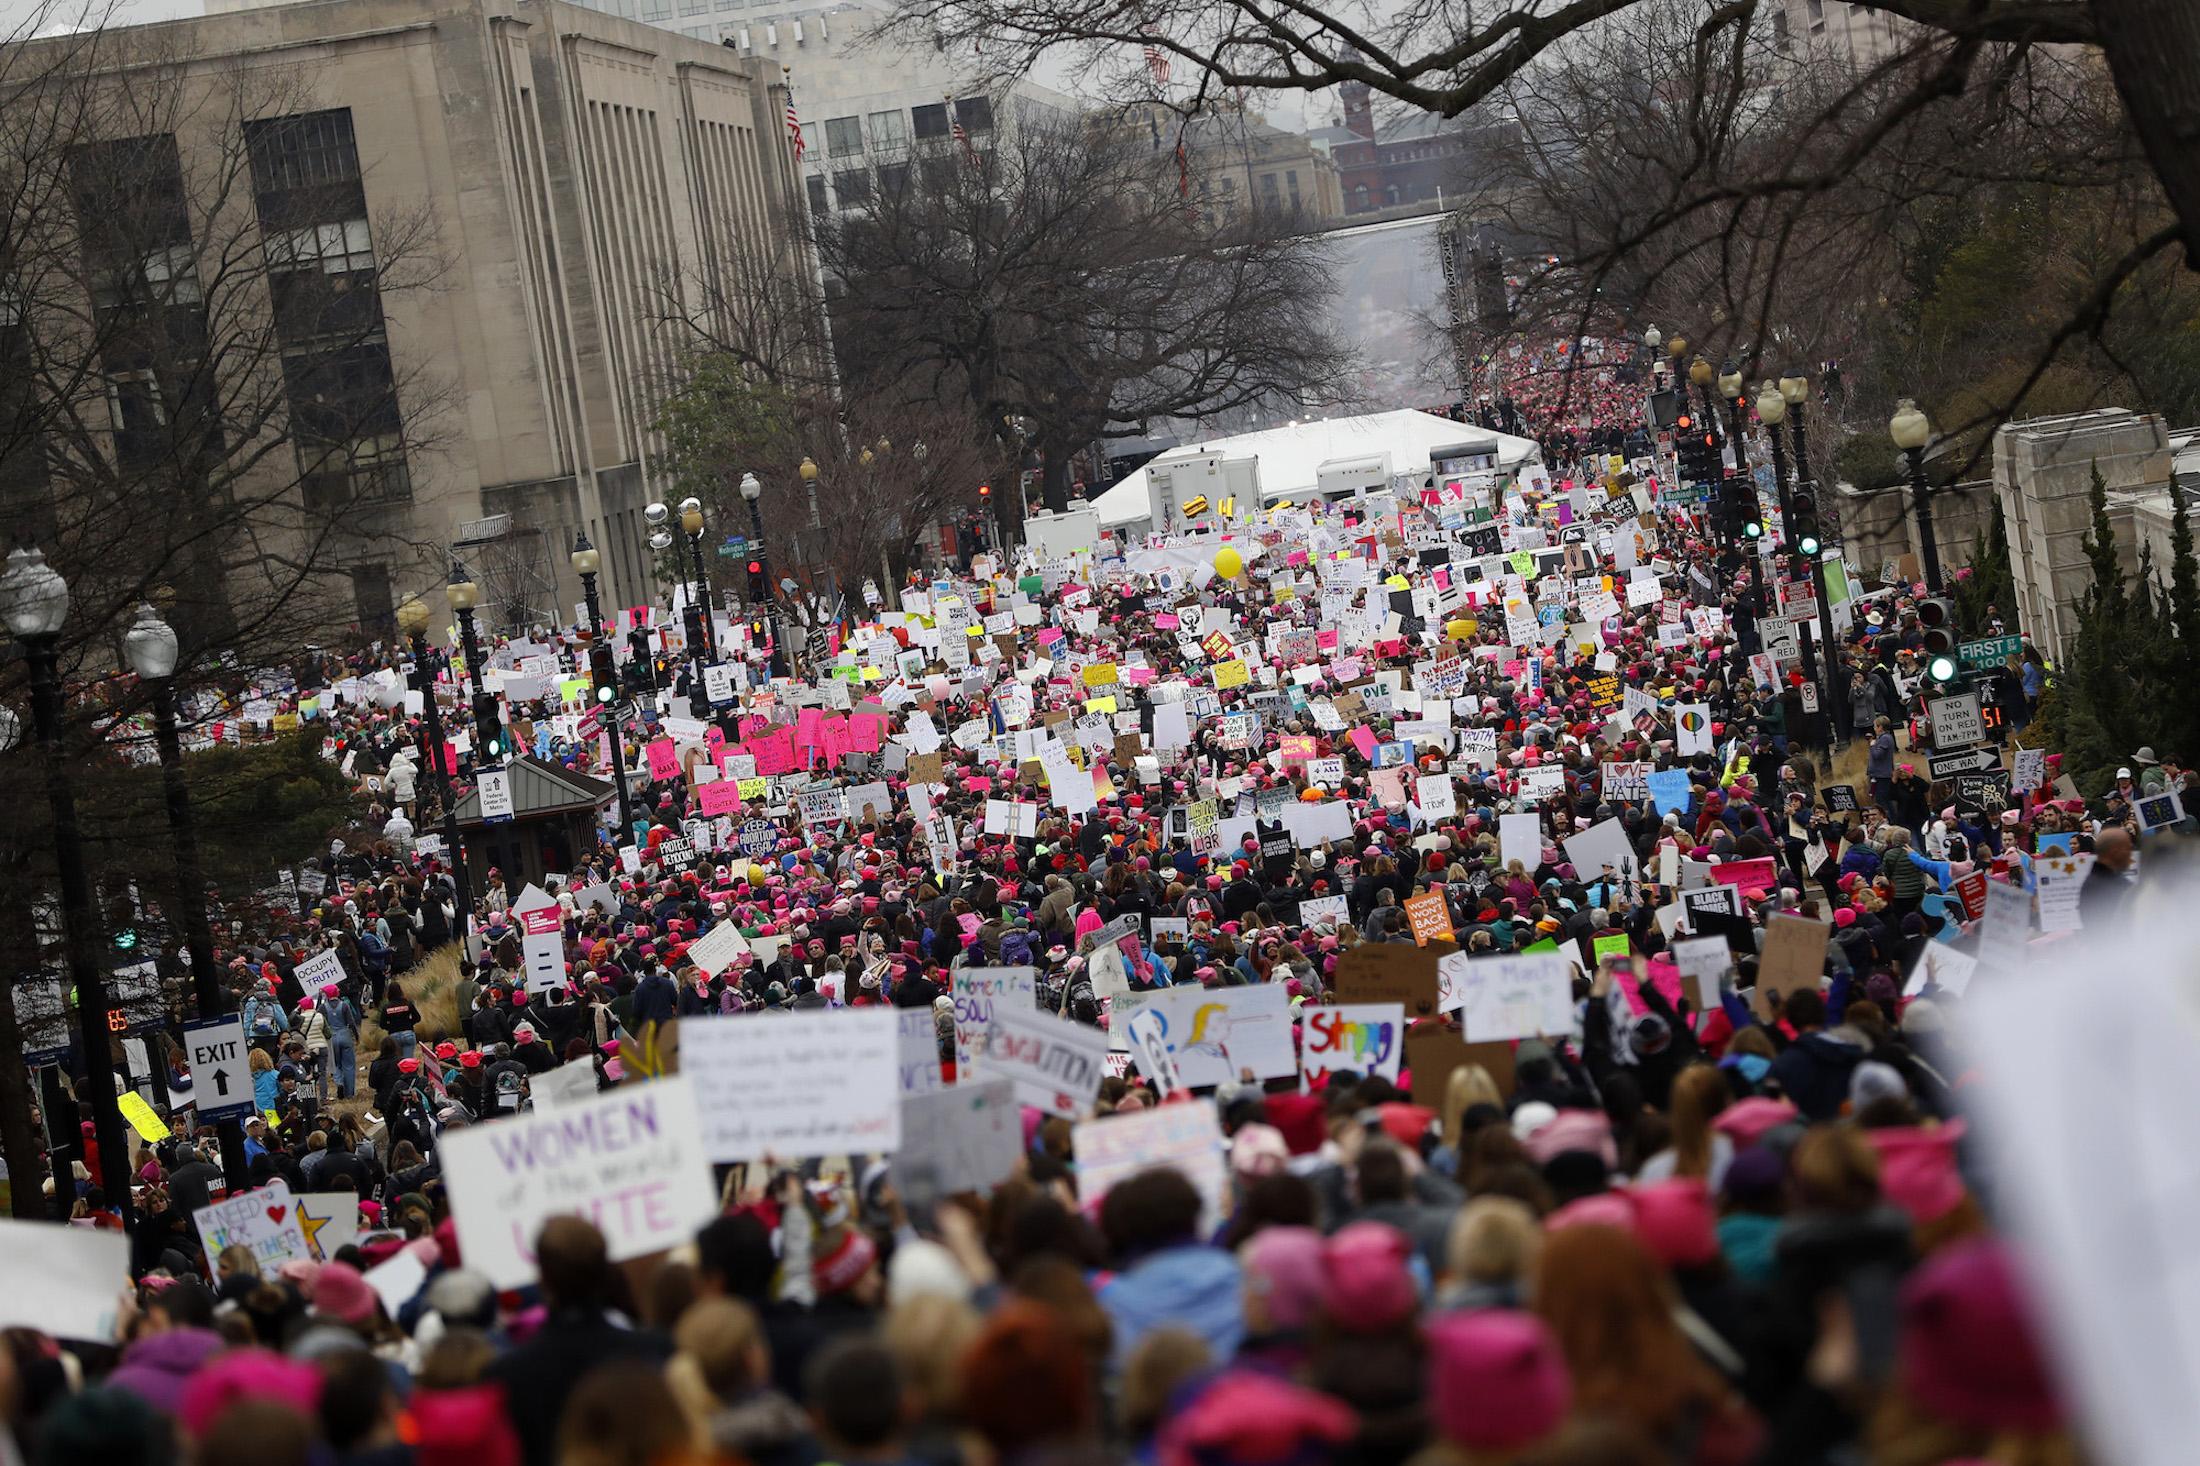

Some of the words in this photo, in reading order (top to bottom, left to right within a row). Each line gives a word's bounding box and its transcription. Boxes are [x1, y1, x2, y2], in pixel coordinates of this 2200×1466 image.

[1766, 619, 1790, 631] STOP
[1778, 647, 1796, 657] RED
[1960, 640, 2004, 660] FIRST
[1432, 657, 1462, 674] WOMEN
[1976, 655, 2007, 670] 100
[1586, 680, 1600, 688] WE
[1599, 676, 1618, 685] WILL
[1590, 682, 1619, 694] DEFEAT
[1363, 683, 1390, 699] OVE
[1599, 690, 1616, 698] THE
[1592, 697, 1613, 707] DARK
[1612, 694, 1625, 703] SID
[1945, 700, 1962, 709] NO
[1223, 716, 1246, 727] DON'T
[1942, 711, 1970, 720] TURN
[1982, 707, 2002, 728] 51
[1225, 725, 1243, 735] GRAB
[1938, 723, 1954, 732] ON
[1957, 719, 1978, 729] RED
[1462, 730, 1494, 743] TRUTH
[1940, 730, 1979, 743] 7AM-7PM
[1936, 761, 1957, 773] ONE
[1957, 756, 1980, 770] WAY
[1609, 778, 1648, 788] TRUMPS
[1983, 783, 1998, 794] SO
[486, 792, 504, 800] Federal
[1603, 787, 1648, 800] HATE
[1983, 791, 2003, 804] FAR
[484, 798, 500, 806] Center
[1425, 798, 1446, 810] TRUMP
[809, 811, 838, 821] HUMAN
[743, 820, 768, 832] KEEP
[740, 829, 777, 847] ABORTION
[660, 837, 693, 854] PROTECT
[748, 841, 775, 856] LEGAL
[1408, 896, 1442, 911] WOMEN
[1693, 890, 1725, 906] BLACK
[1411, 904, 1444, 919] WON'T
[1414, 913, 1447, 929] BACK
[1417, 922, 1449, 939] DOWN
[297, 954, 334, 980] OCCUPY
[305, 966, 339, 988] TRUTH
[107, 1008, 129, 1032] 65
[195, 1039, 238, 1066] EXIT
[492, 1096, 660, 1172] WOMEN
[207, 1177, 223, 1192] RISE
[215, 1198, 262, 1227] NEED
[512, 1180, 676, 1258] UITE
